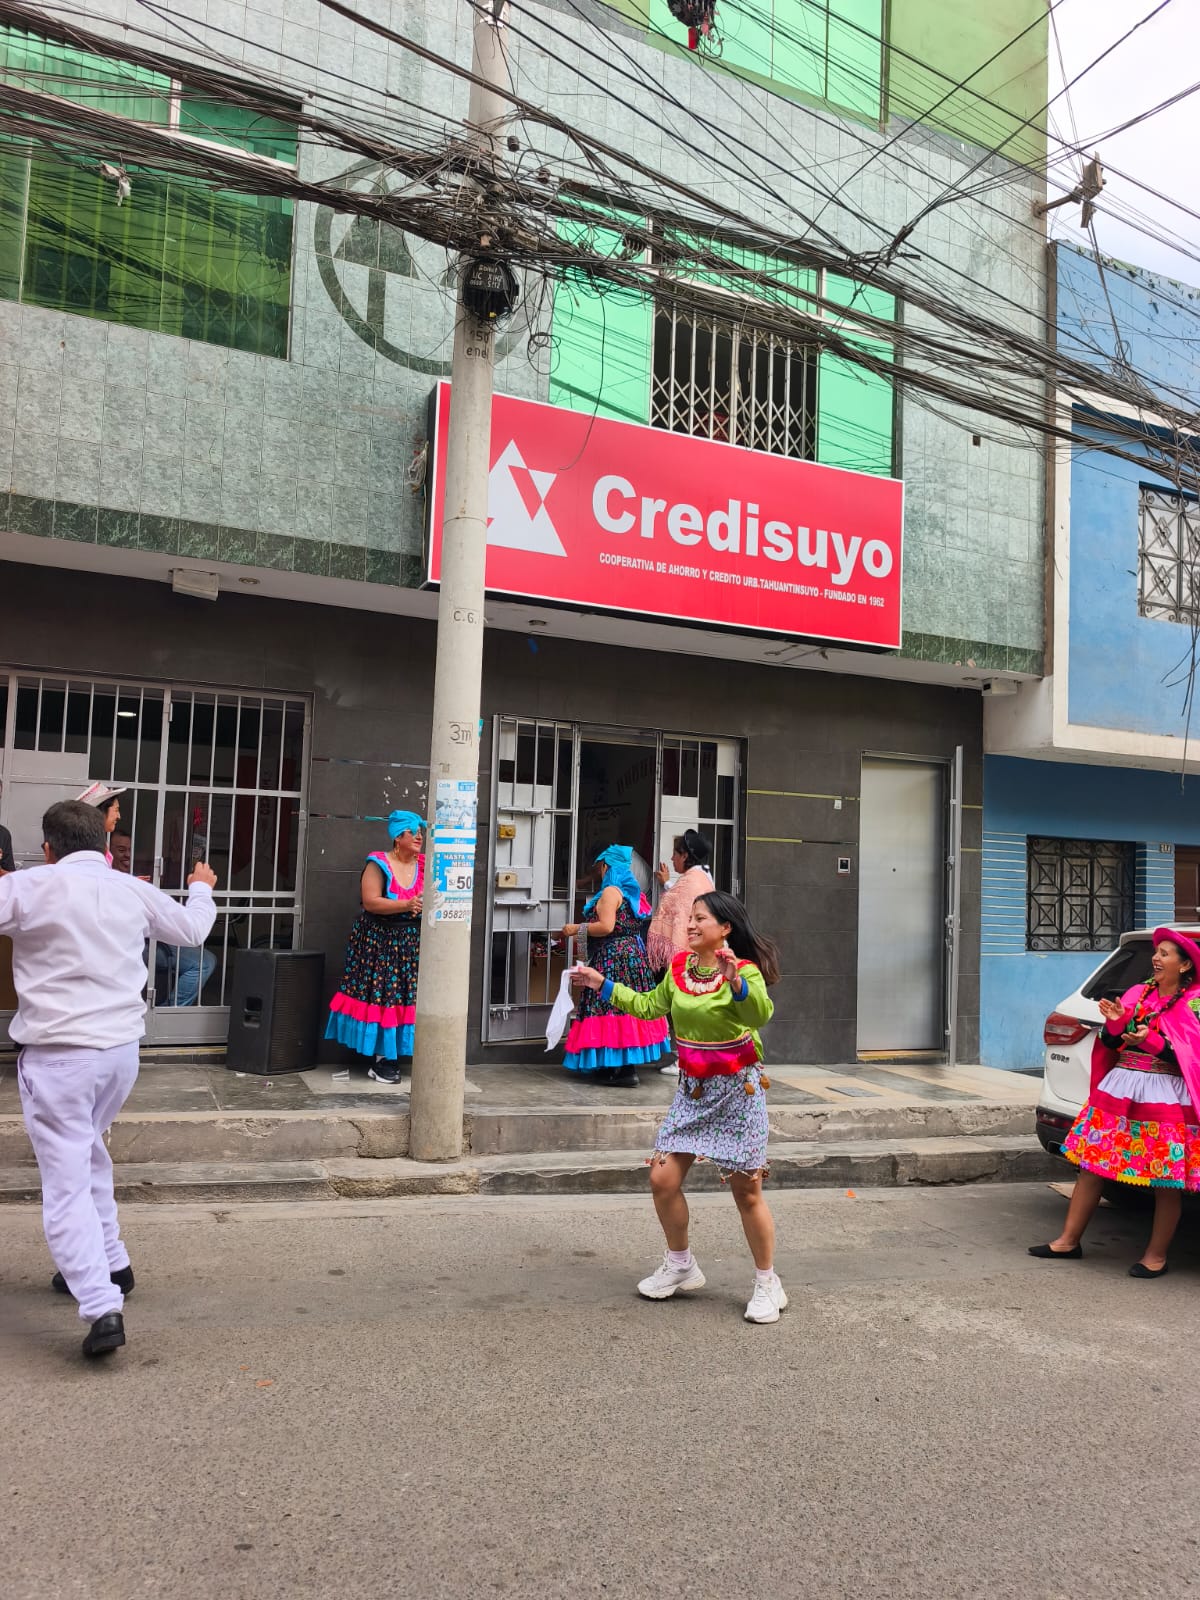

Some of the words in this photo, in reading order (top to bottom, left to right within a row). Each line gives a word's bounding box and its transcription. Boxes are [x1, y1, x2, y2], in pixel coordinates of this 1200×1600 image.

[592, 475, 894, 586] Credisuyo
[599, 552, 654, 571] COOPERATIVA
[656, 562, 666, 573] DE
[668, 564, 701, 579] AHORRO
[702, 569, 708, 580] Y
[709, 571, 741, 585] CREDITO
[824, 588, 856, 603] FUNDADO
[857, 594, 867, 605] EN
[869, 596, 885, 607] 1962
